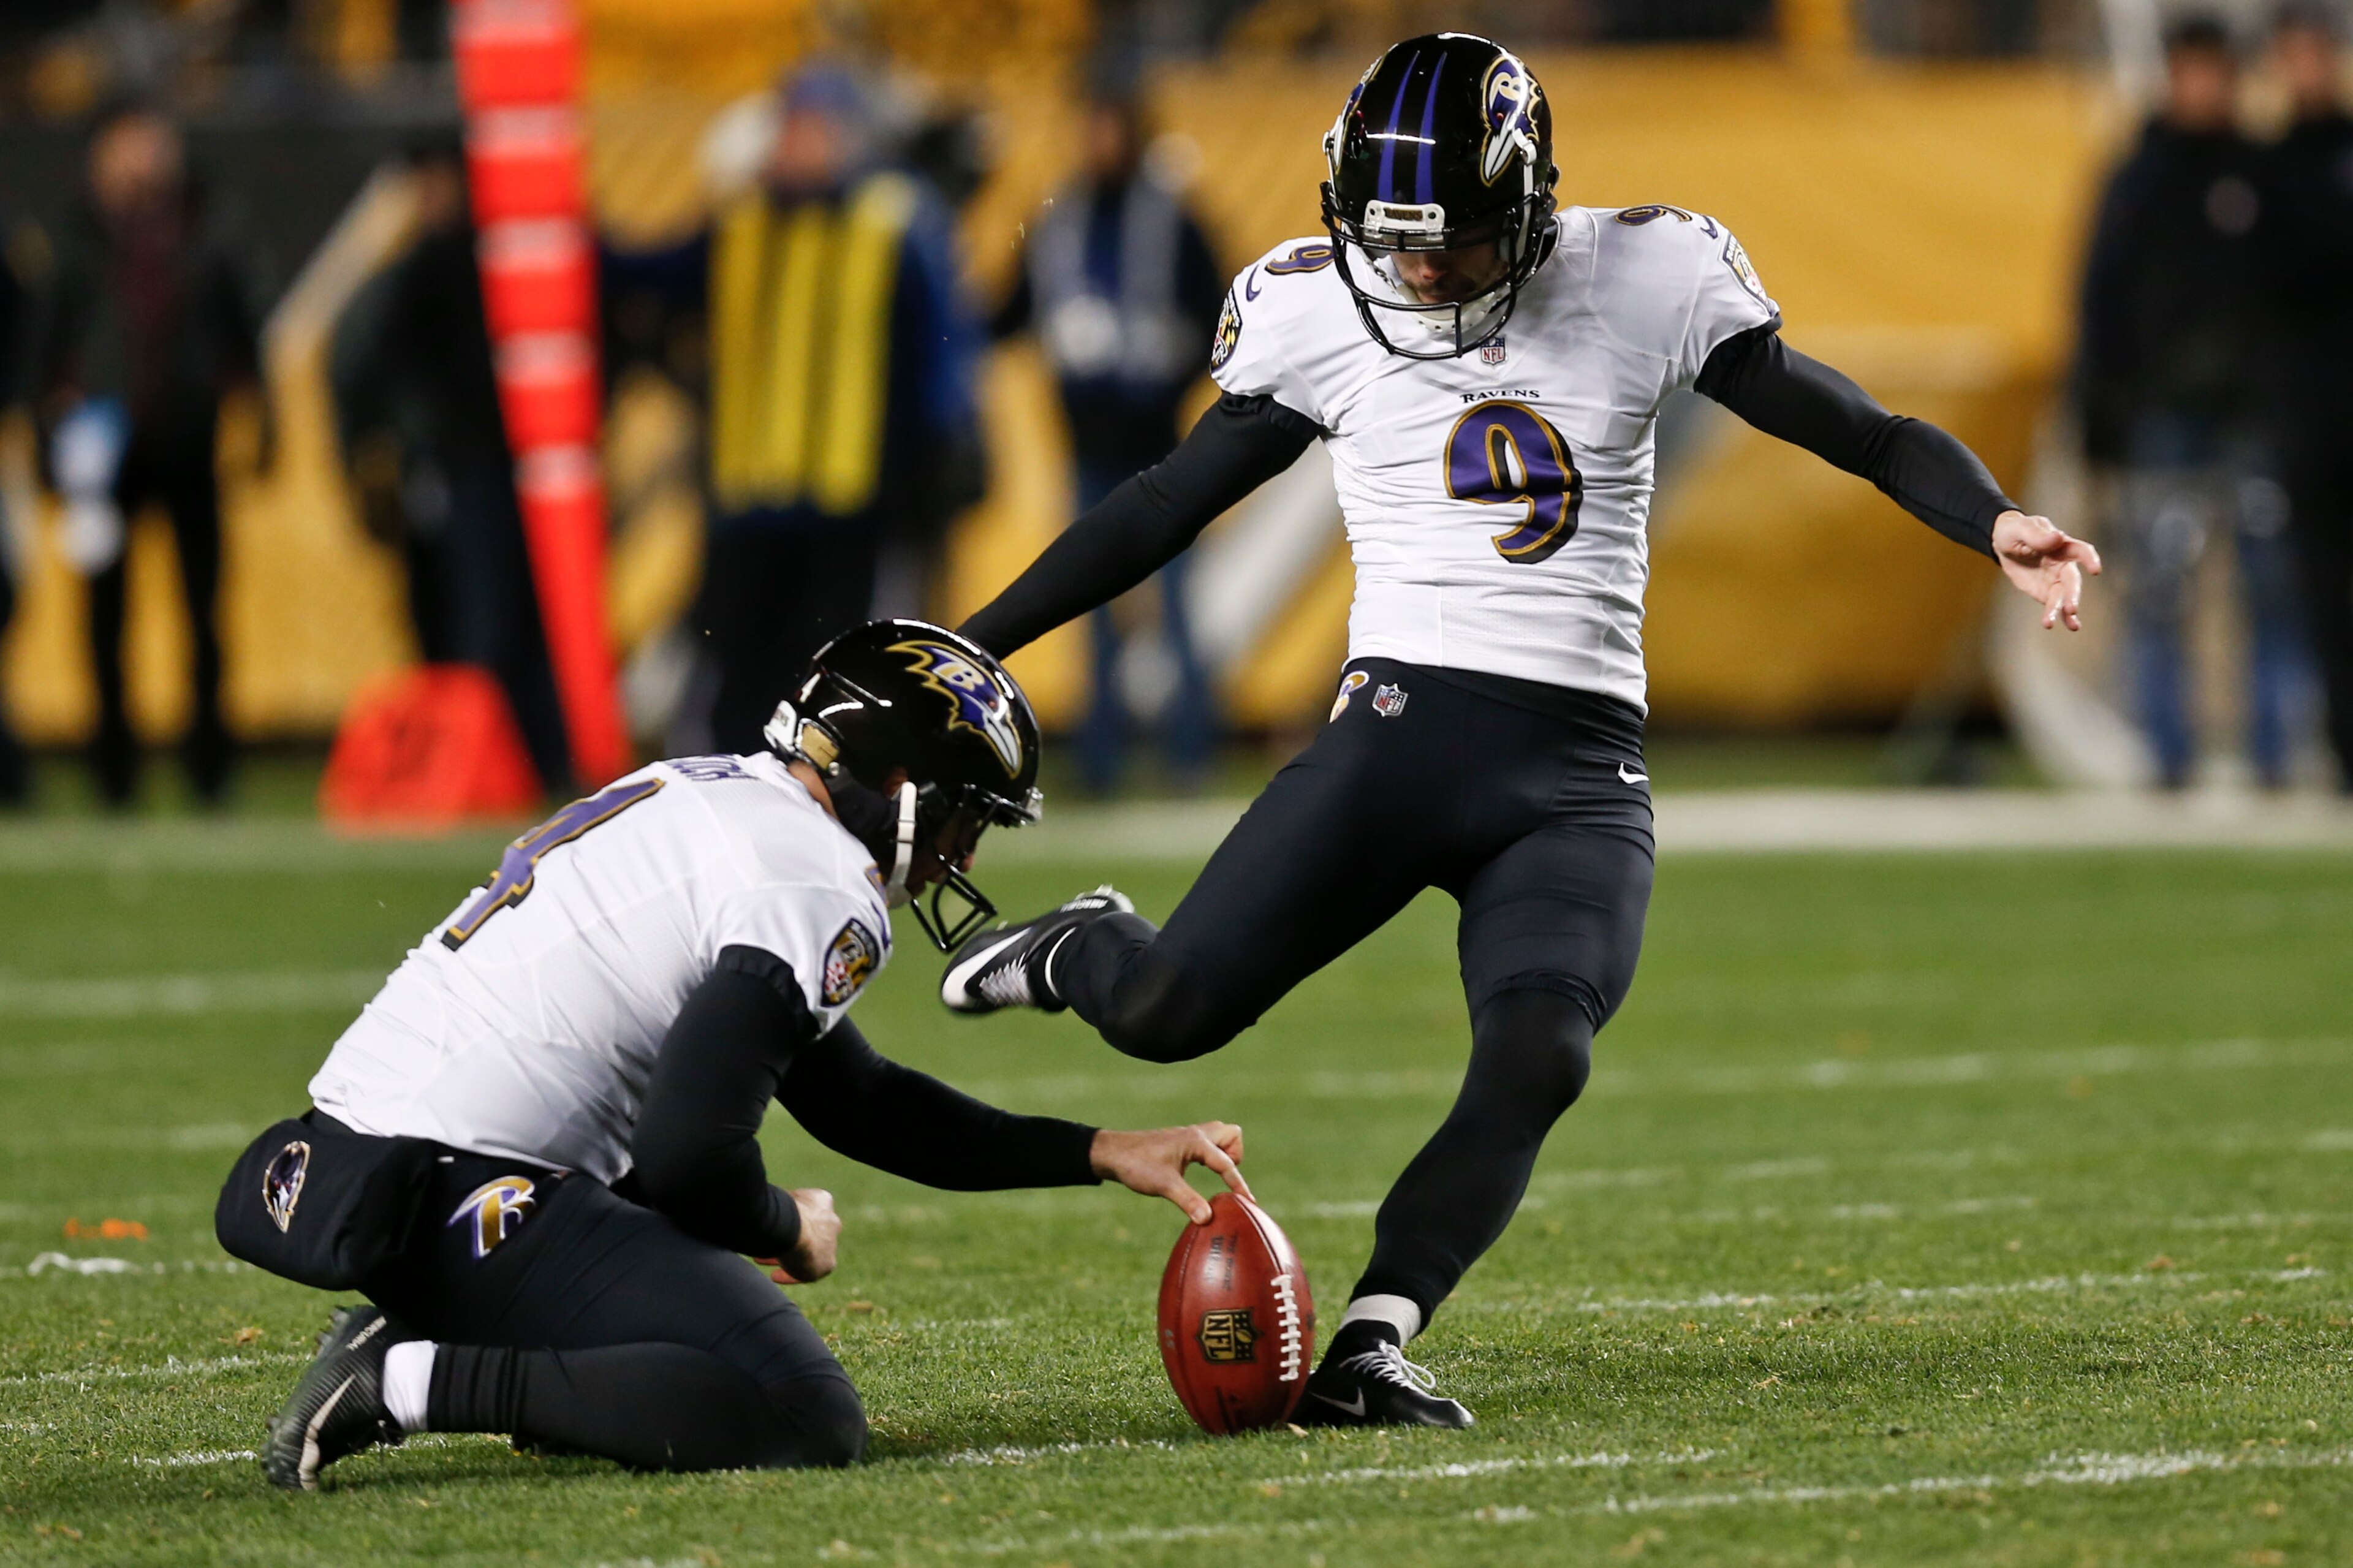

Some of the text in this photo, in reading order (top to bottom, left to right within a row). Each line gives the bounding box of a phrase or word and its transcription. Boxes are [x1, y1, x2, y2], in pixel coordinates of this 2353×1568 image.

[1264, 244, 1335, 275] 9
[1482, 347, 1504, 362] NFL
[1460, 390, 1540, 403] RAVENS
[1443, 399, 1583, 564] 9
[441, 777, 667, 951] 4
[1206, 1317, 1232, 1358] NFL
